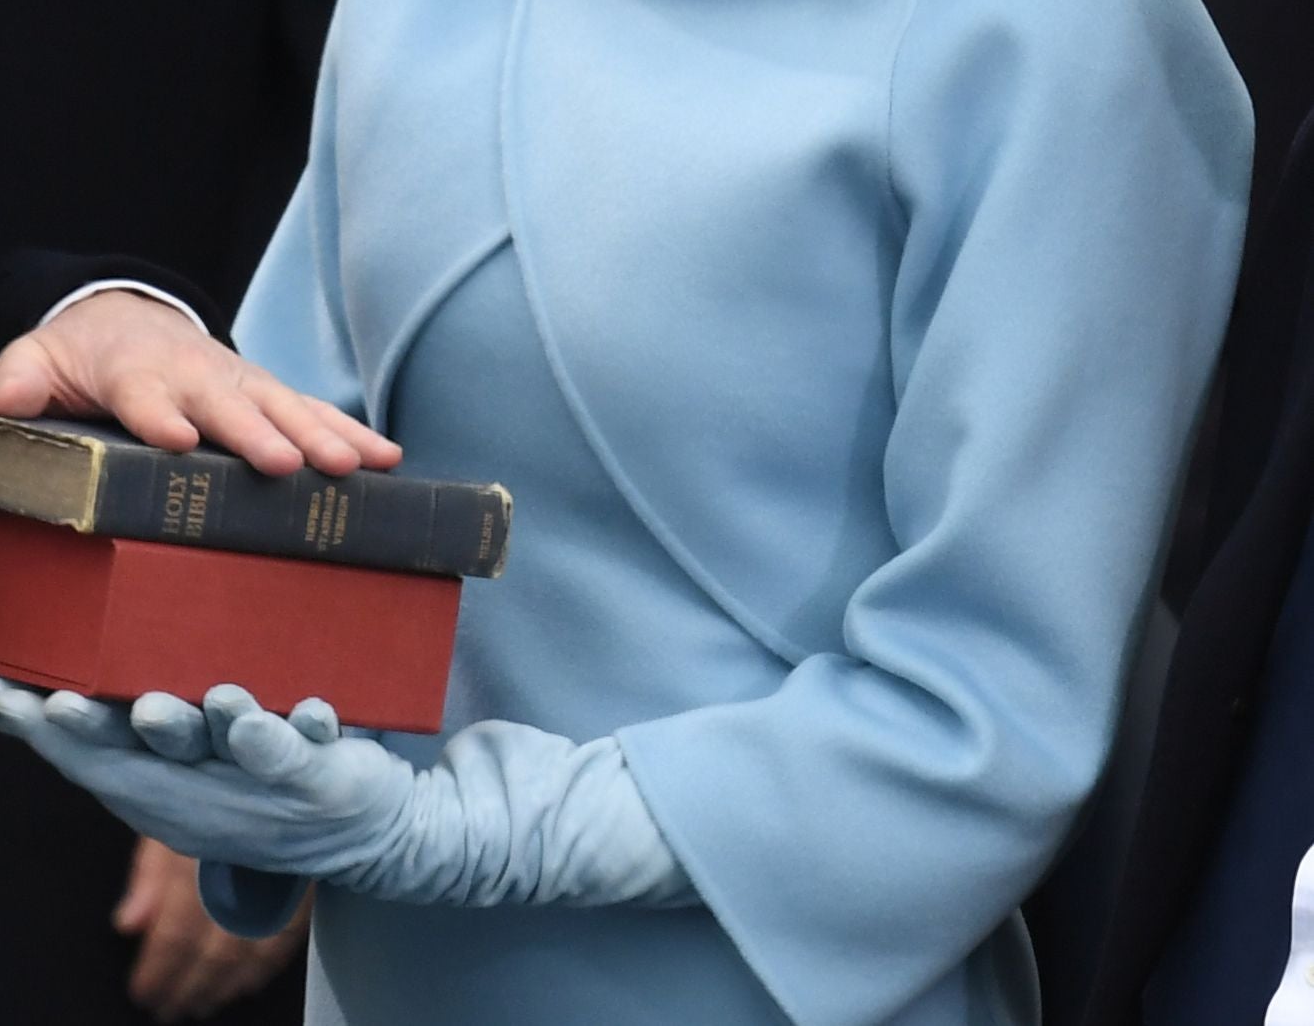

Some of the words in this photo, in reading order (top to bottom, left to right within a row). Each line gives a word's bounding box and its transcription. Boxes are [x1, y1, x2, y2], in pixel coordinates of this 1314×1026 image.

[162, 472, 187, 533] HOLY
[186, 472, 211, 537] BIBLE
[332, 494, 349, 545] VERSION
